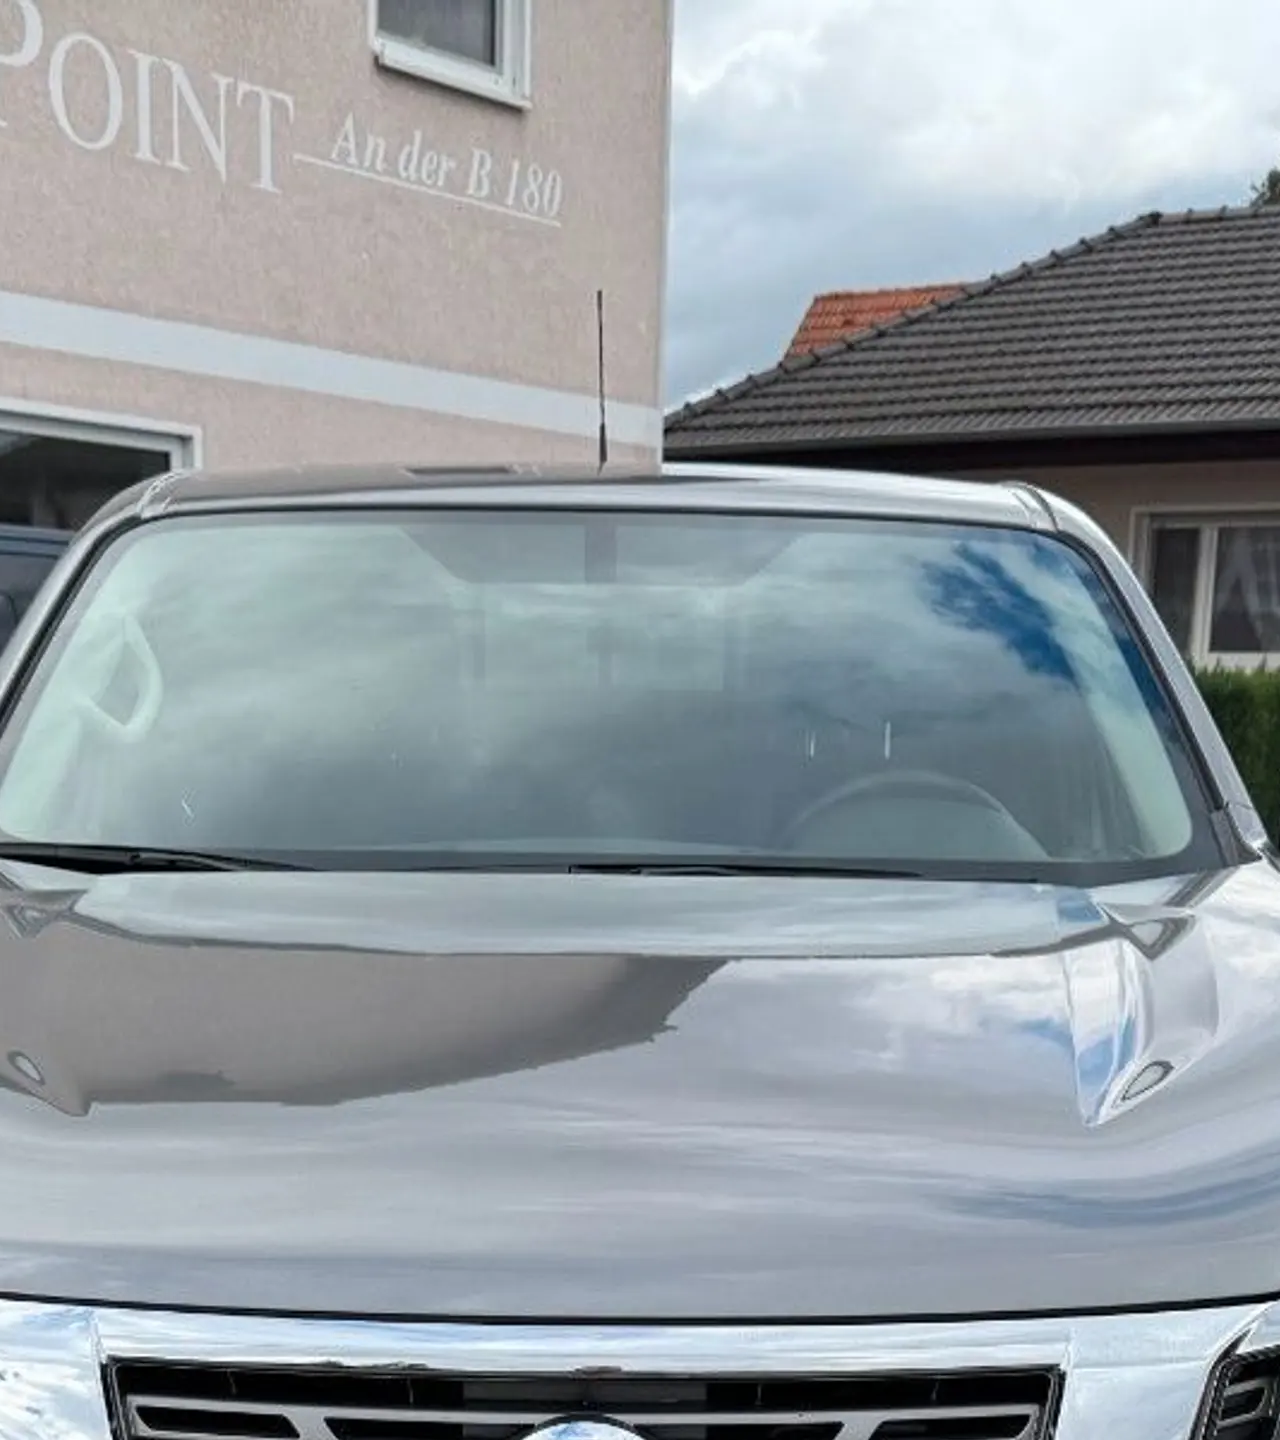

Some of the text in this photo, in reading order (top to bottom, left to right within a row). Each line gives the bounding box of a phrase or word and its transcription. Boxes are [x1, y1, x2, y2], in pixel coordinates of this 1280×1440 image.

[330, 111, 389, 173] An
[397, 129, 457, 188] der
[467, 148, 493, 198] B
[505, 158, 563, 217] 180
